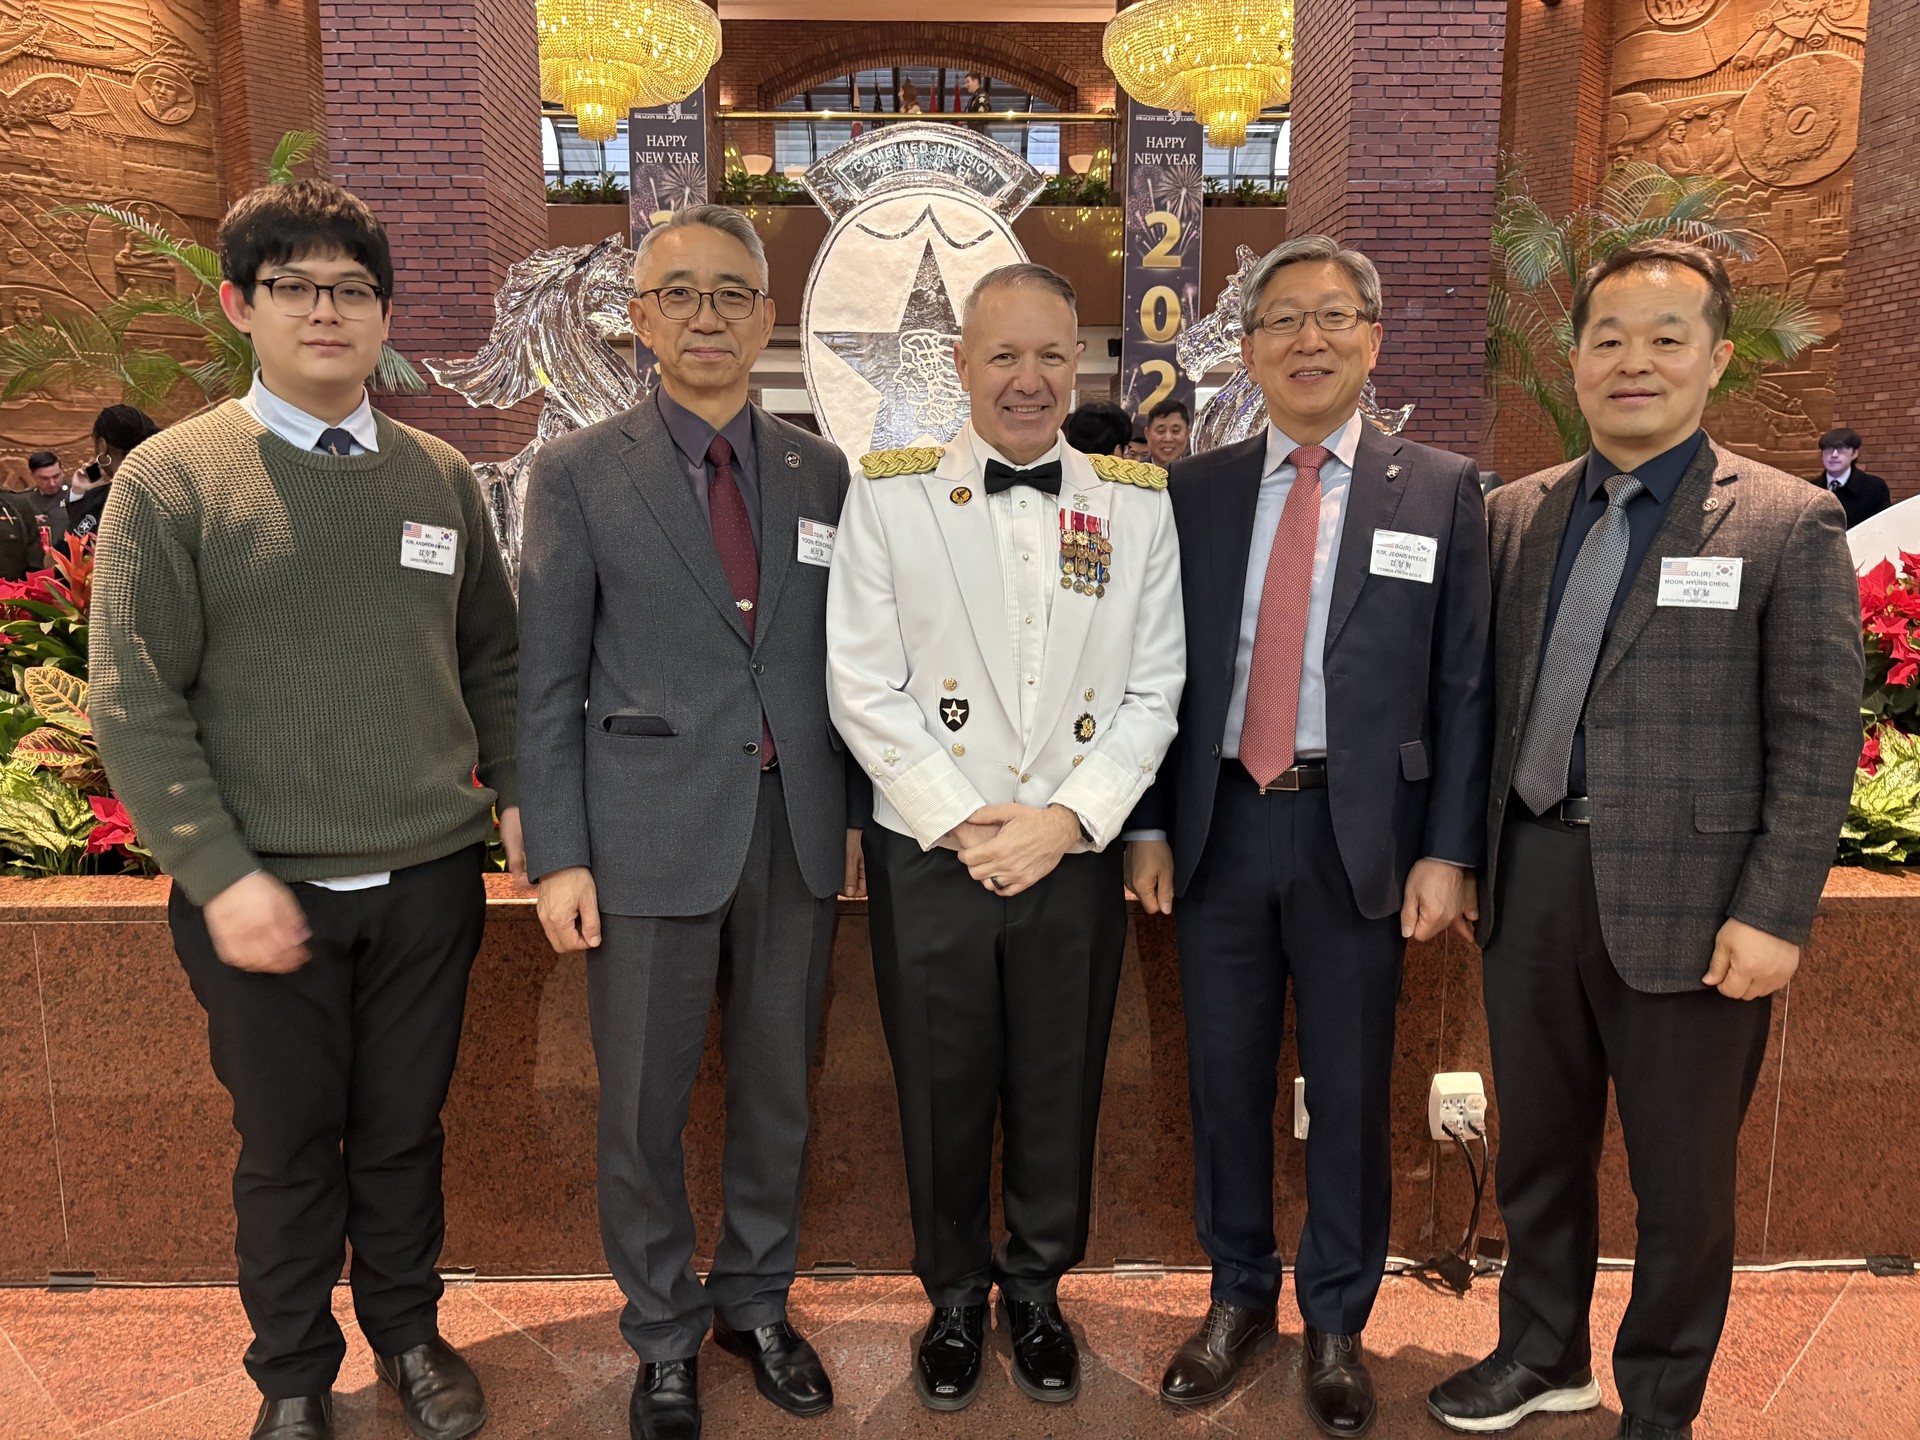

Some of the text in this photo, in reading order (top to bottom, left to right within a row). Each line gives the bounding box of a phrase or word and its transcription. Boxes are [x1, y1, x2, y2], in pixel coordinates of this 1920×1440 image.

[646, 135, 688, 147] HAPPY
[1146, 136, 1187, 148] HAPPY
[635, 152, 700, 164] NEW YEAR
[854, 143, 997, 182] COMBINED DIVISION
[1134, 153, 1197, 165] NEW YEAR
[1395, 543, 1411, 552] BG(R)
[1408, 554, 1428, 563] HYEOK
[1685, 570, 1711, 578] COL(R)
